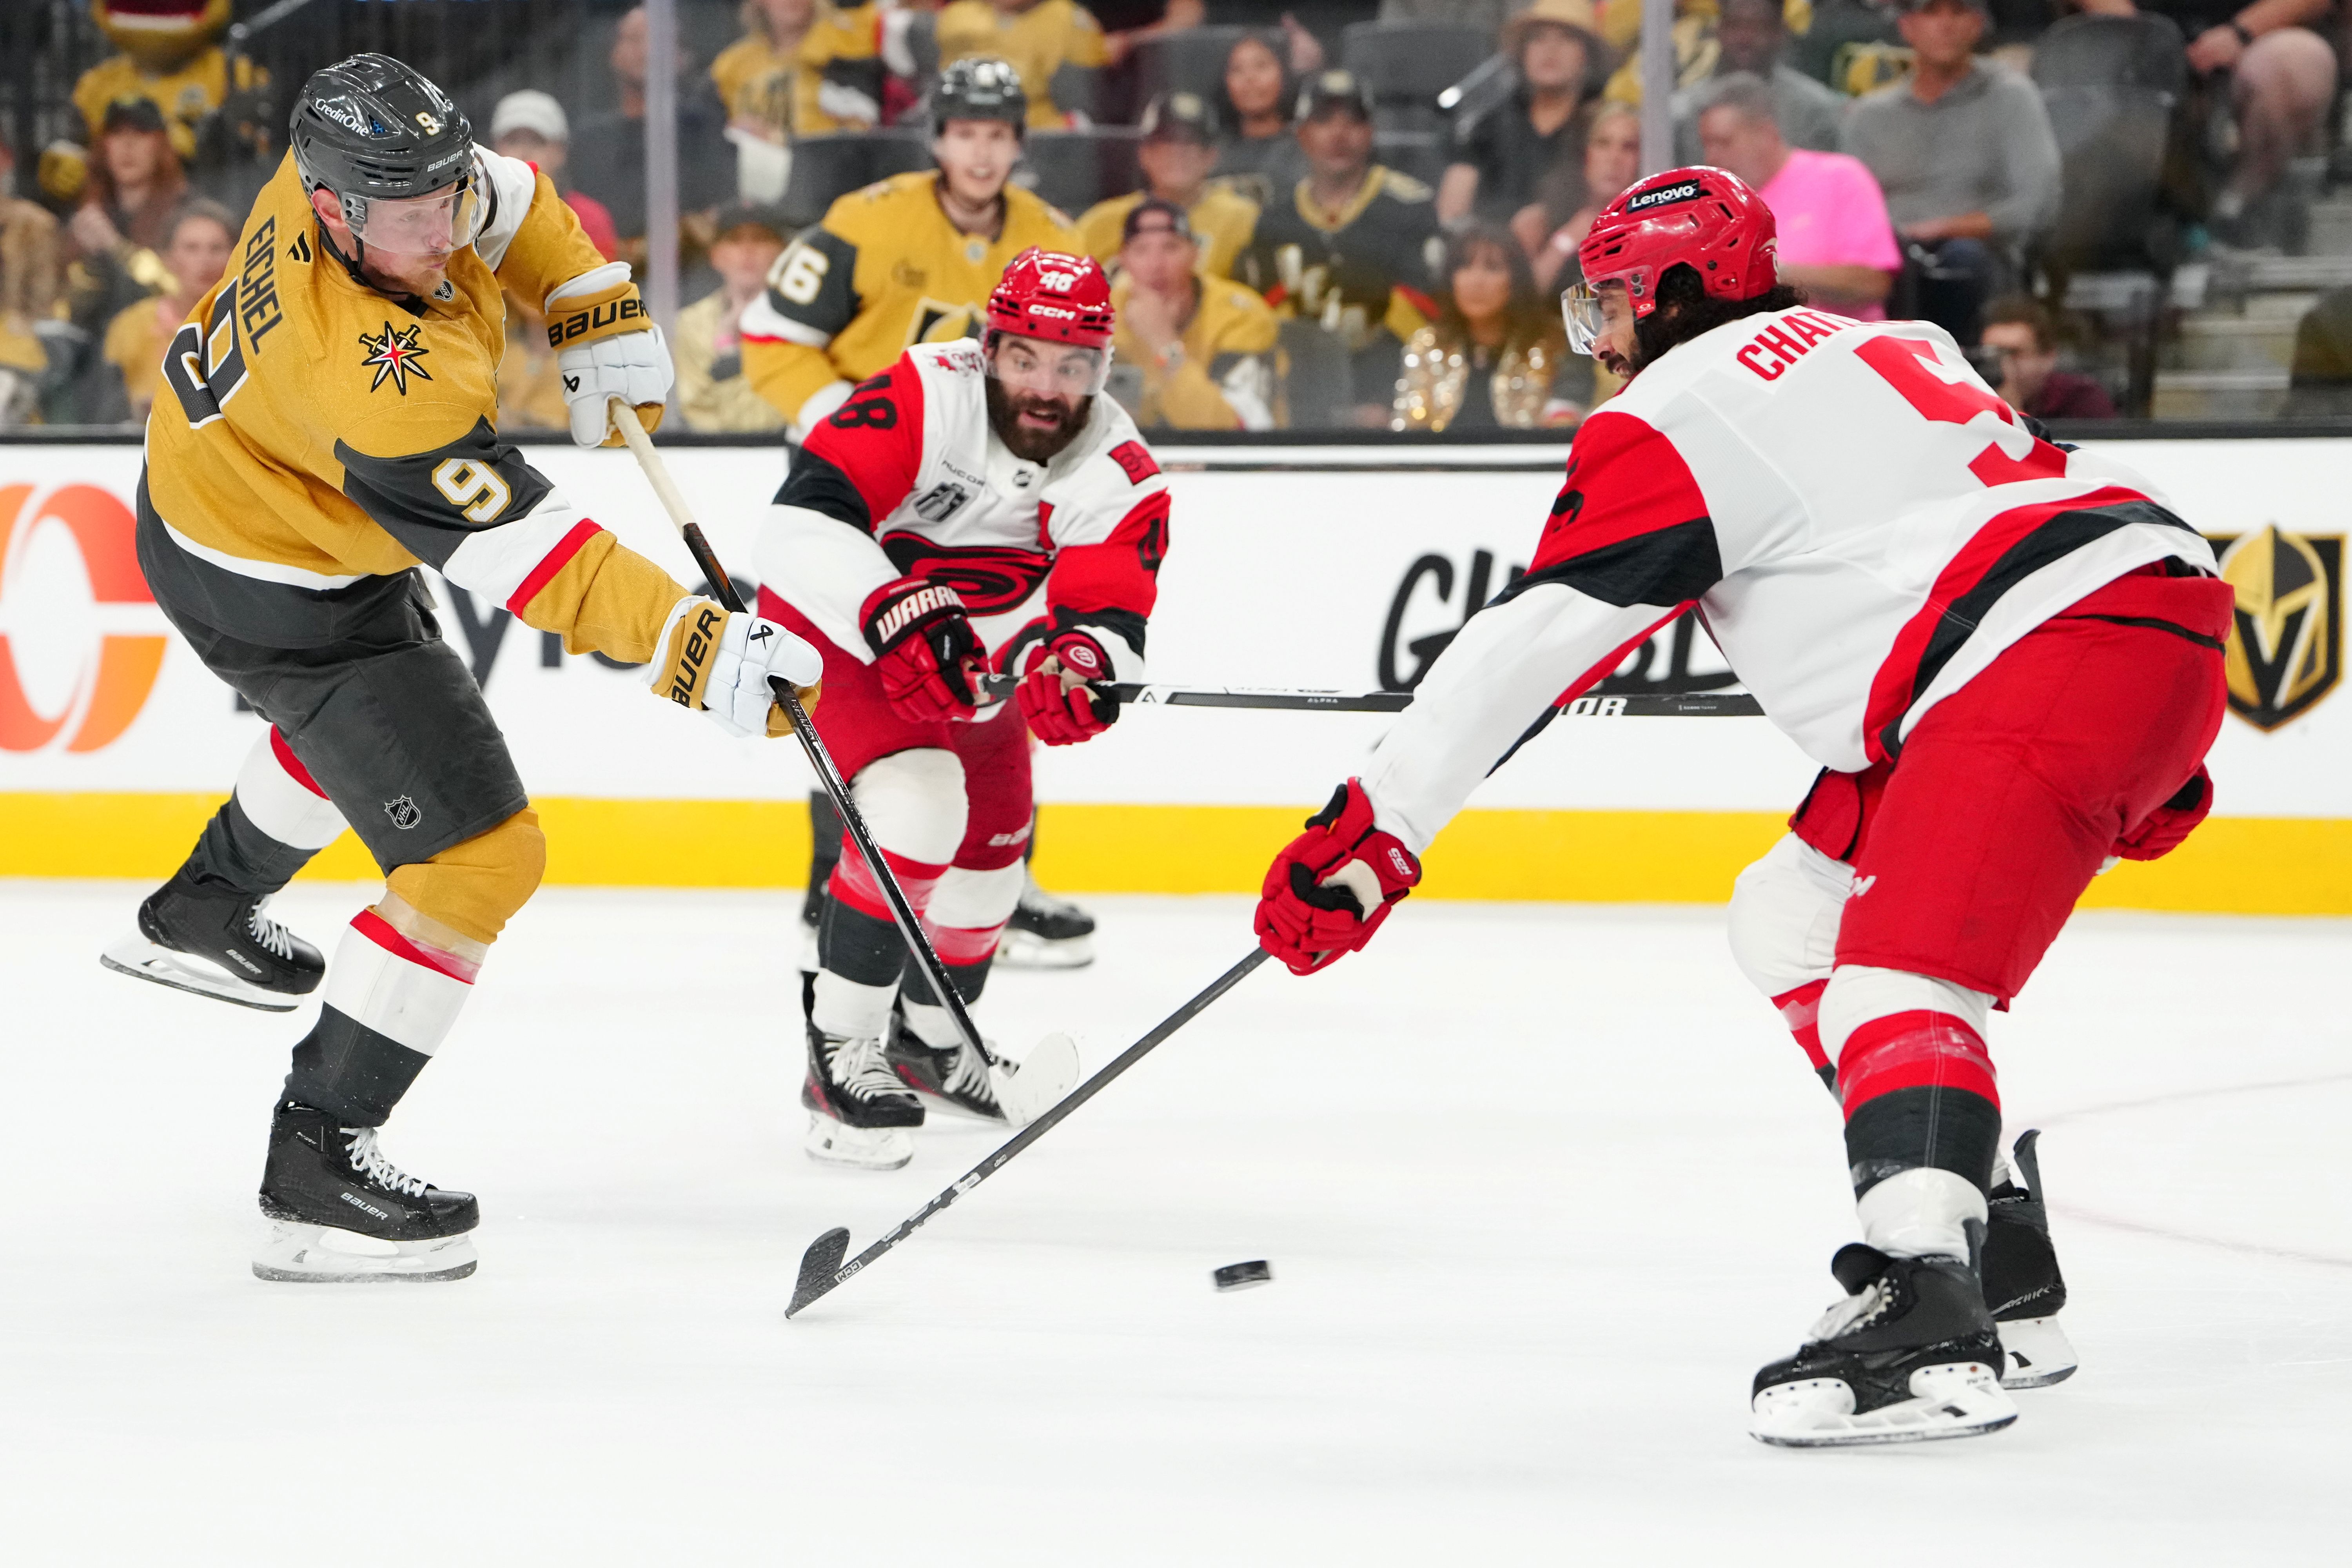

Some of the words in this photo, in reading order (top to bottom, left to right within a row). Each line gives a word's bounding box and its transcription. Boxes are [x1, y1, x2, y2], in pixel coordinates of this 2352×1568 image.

[316, 98, 369, 136] CreditOne
[416, 111, 440, 136] 9
[1632, 185, 1694, 208] Lenovo
[240, 214, 283, 356] EICHEL
[1028, 304, 1076, 320] CCM
[161, 275, 249, 430] 9
[431, 457, 512, 523] 9
[671, 608, 722, 708] AUER
[397, 804, 410, 824] NHL
[837, 1262, 860, 1282] CCM
